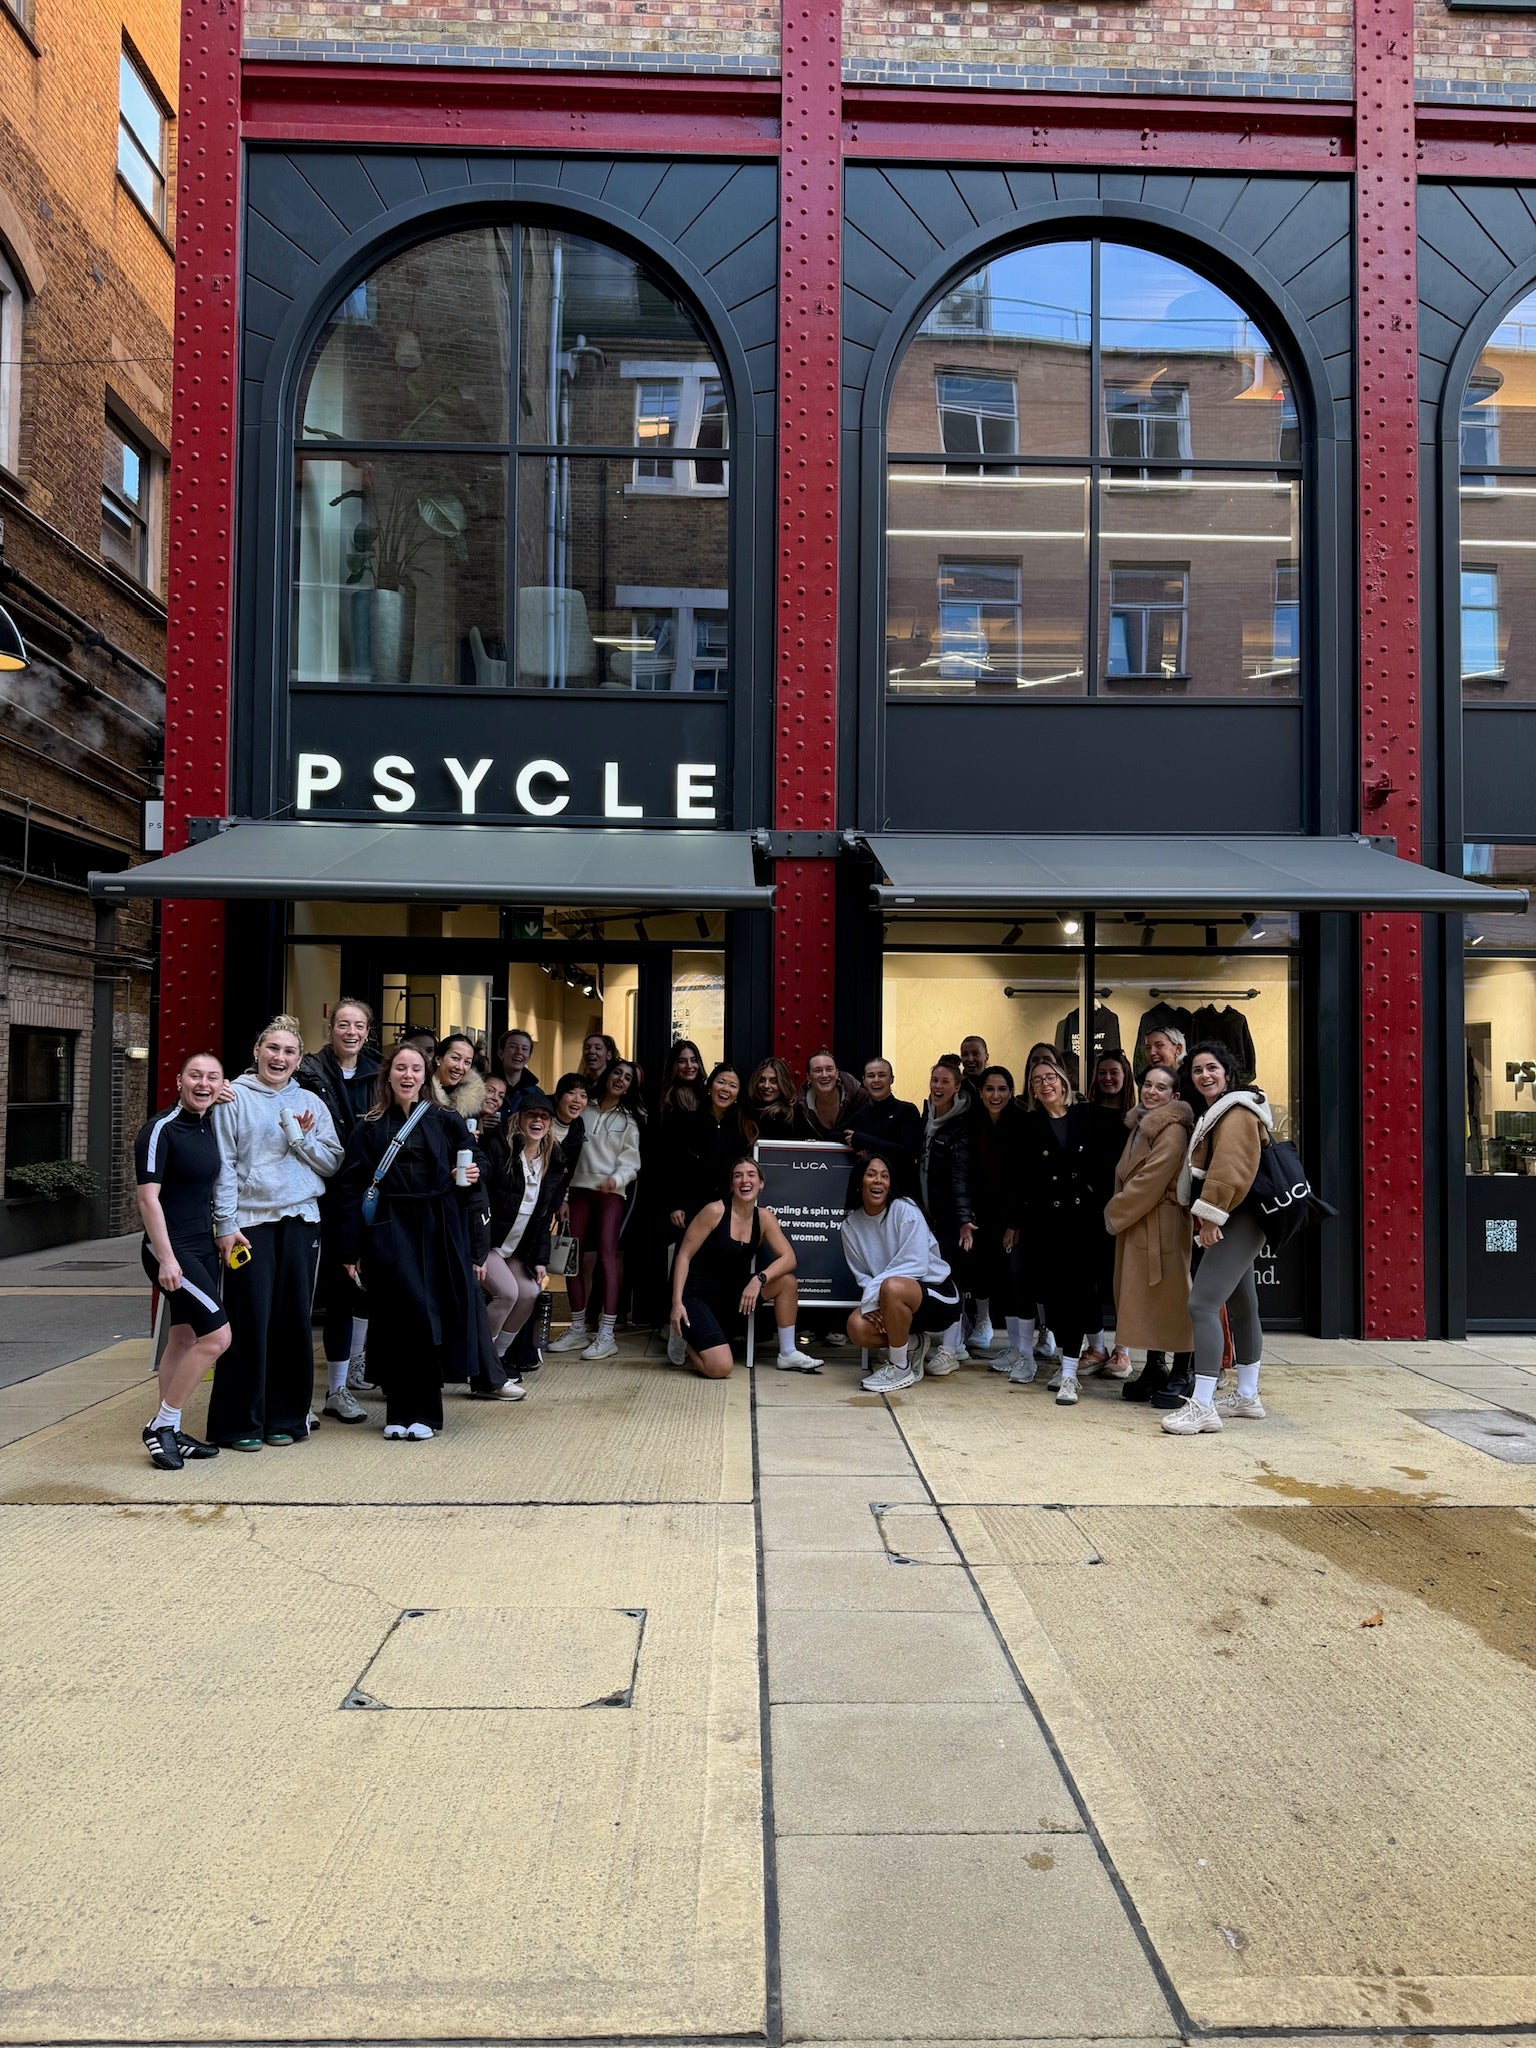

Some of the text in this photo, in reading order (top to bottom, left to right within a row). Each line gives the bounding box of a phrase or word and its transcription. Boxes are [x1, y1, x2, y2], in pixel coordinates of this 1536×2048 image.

[297, 753, 716, 819] PSYCLE
[792, 1161, 828, 1170] LUCA
[765, 1205, 801, 1216] Cycling
[802, 1206, 809, 1215] &
[810, 1206, 830, 1217] spin
[778, 1219, 842, 1230] for women, by
[790, 1233, 829, 1242] women.
